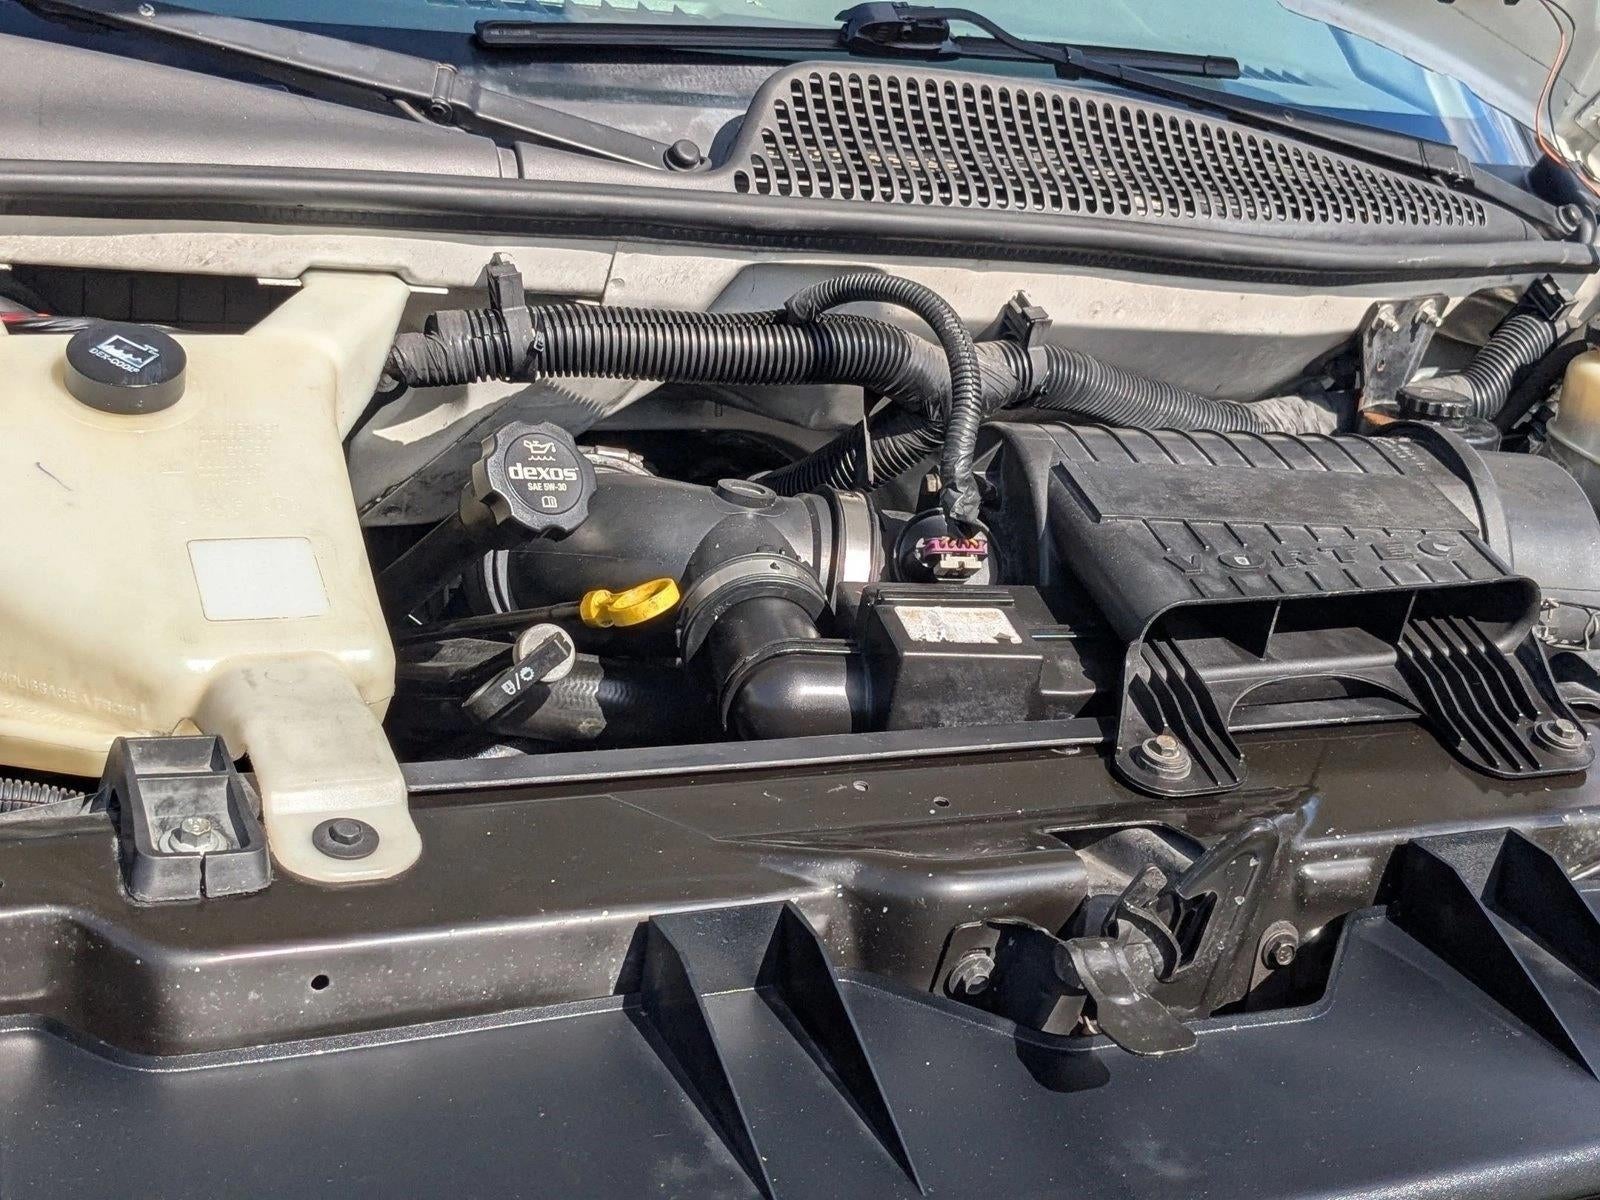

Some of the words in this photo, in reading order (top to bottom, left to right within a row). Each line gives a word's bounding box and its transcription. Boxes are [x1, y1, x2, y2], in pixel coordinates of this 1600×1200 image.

[508, 462, 577, 481] dexos
[527, 482, 543, 491] SAE
[543, 482, 567, 491] 5W-30
[1163, 537, 1463, 575] VORTEC
